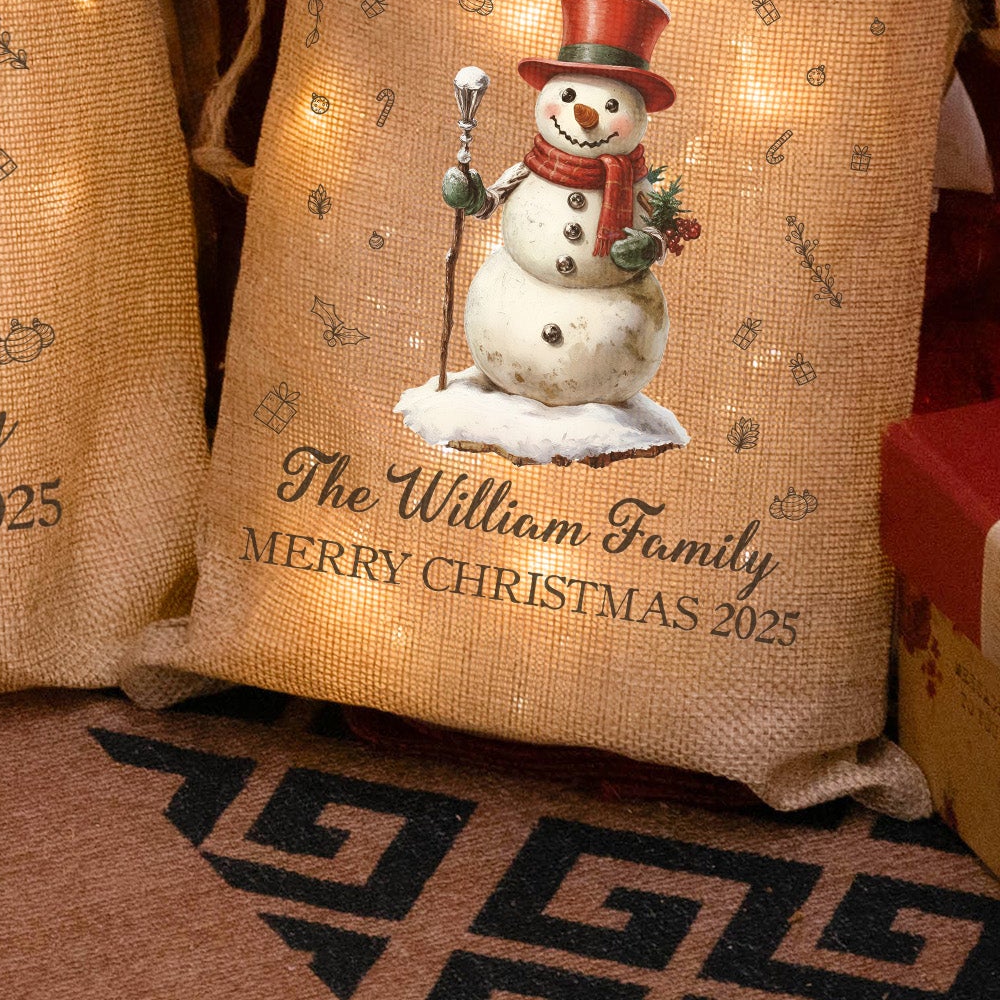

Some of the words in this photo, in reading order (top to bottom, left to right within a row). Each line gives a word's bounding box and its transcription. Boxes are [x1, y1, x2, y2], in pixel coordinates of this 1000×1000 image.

[239, 526, 413, 586] MERRY
[421, 555, 700, 632] CHRISTMAS
[709, 602, 801, 648] 2025
[276, 445, 379, 514] The
[386, 462, 592, 548] William
[601, 497, 780, 600] Family
